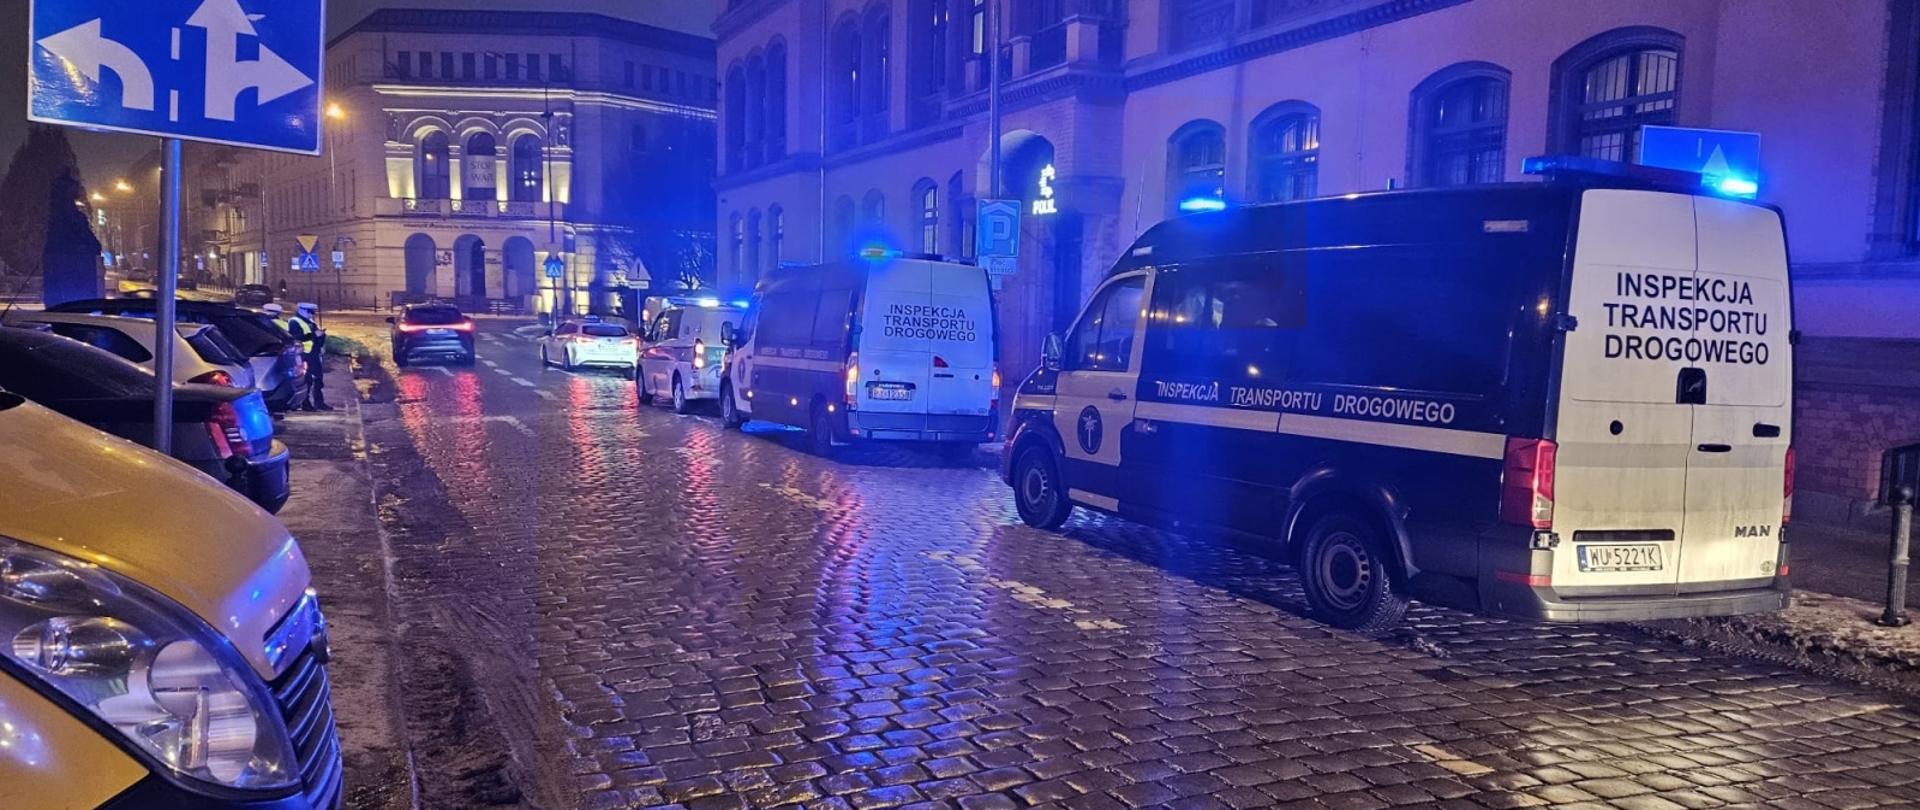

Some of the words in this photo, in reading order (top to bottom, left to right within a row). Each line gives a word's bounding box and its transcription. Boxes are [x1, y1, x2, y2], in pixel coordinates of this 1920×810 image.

[984, 215, 1011, 249] P
[1616, 272, 1754, 305] INSPEKCJA
[883, 315, 976, 331] TRANSPORTU
[889, 303, 967, 319] INSPEKCJA
[1603, 302, 1768, 336] TRANSPORTU
[884, 326, 977, 342] DROGOWEGO
[1604, 334, 1770, 365] DROGOWEGO
[1156, 381, 1219, 402] INSPEKCJA
[1230, 386, 1323, 411] TRANSPORTU
[1333, 393, 1456, 424] DROGOWEGO
[1734, 525, 1771, 538] MAN
[1590, 548, 1609, 566] WU
[1614, 547, 1658, 566] 5221K
